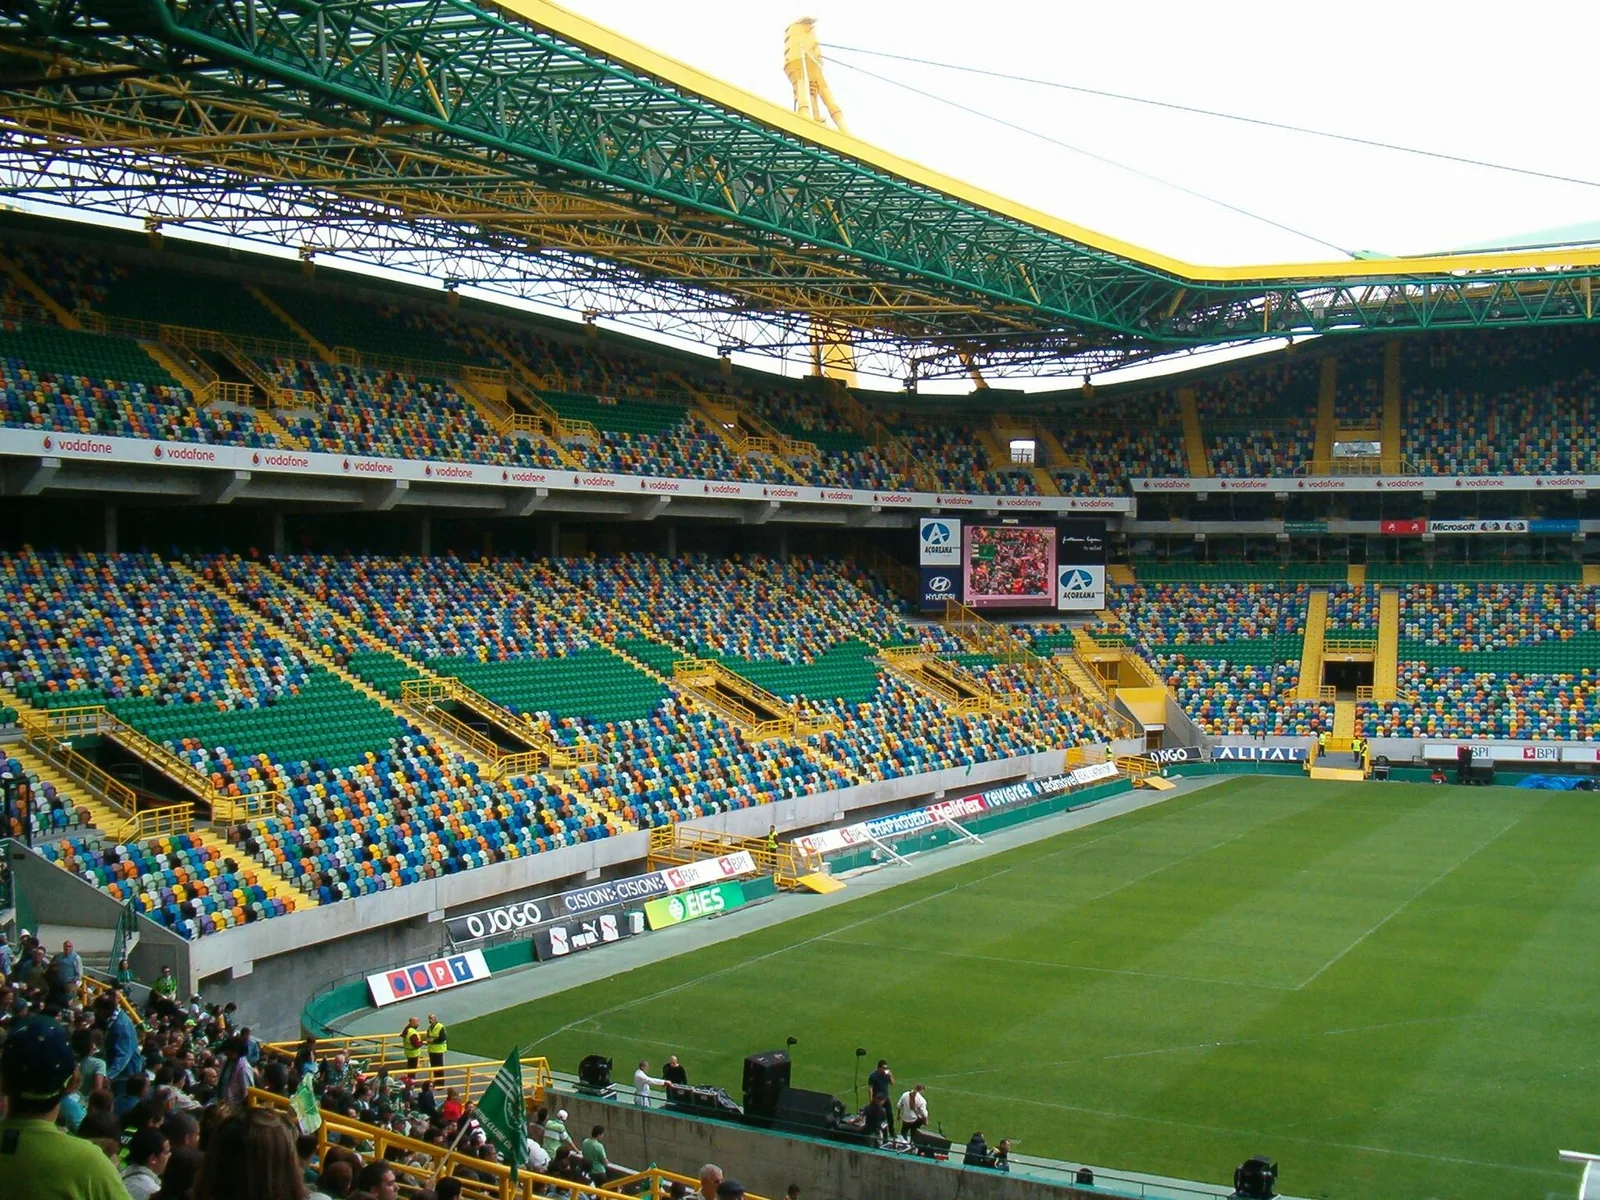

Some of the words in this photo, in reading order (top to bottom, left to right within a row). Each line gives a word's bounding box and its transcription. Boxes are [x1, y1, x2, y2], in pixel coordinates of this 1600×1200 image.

[58, 439, 112, 454] vodafone
[167, 448, 215, 462] vodafone
[264, 455, 309, 468] vodafone
[354, 461, 393, 473] vodafone
[435, 467, 473, 478] vodafone
[511, 471, 546, 483] vodafone
[582, 476, 615, 487] vodafone
[648, 481, 680, 491] vodafone
[1153, 481, 1191, 489] vodafone
[1230, 481, 1267, 489] vodafone
[1308, 480, 1346, 488] vodafone
[1386, 479, 1424, 488] vodafone
[1466, 478, 1505, 487] vodafone
[1546, 478, 1586, 486] vodafone
[711, 485, 741, 495] vodafone
[769, 489, 798, 498] vodafone
[827, 491, 854, 500] vodafone
[881, 495, 912, 503] vodafone
[944, 496, 973, 505] vodafone
[1006, 498, 1042, 507] vodafone
[1080, 499, 1114, 508] vodafone
[1431, 522, 1475, 531] Microsoft
[924, 546, 953, 555] AÇOREANA
[1062, 591, 1096, 600] AÇOREANA
[1536, 748, 1556, 759] BPI
[934, 797, 984, 820] Heliflex
[731, 857, 747, 870] BPI
[681, 868, 700, 884] BPI
[564, 887, 609, 911] CISION
[616, 877, 659, 899] CISION
[467, 916, 485, 937] O
[489, 902, 542, 934] JOGO
